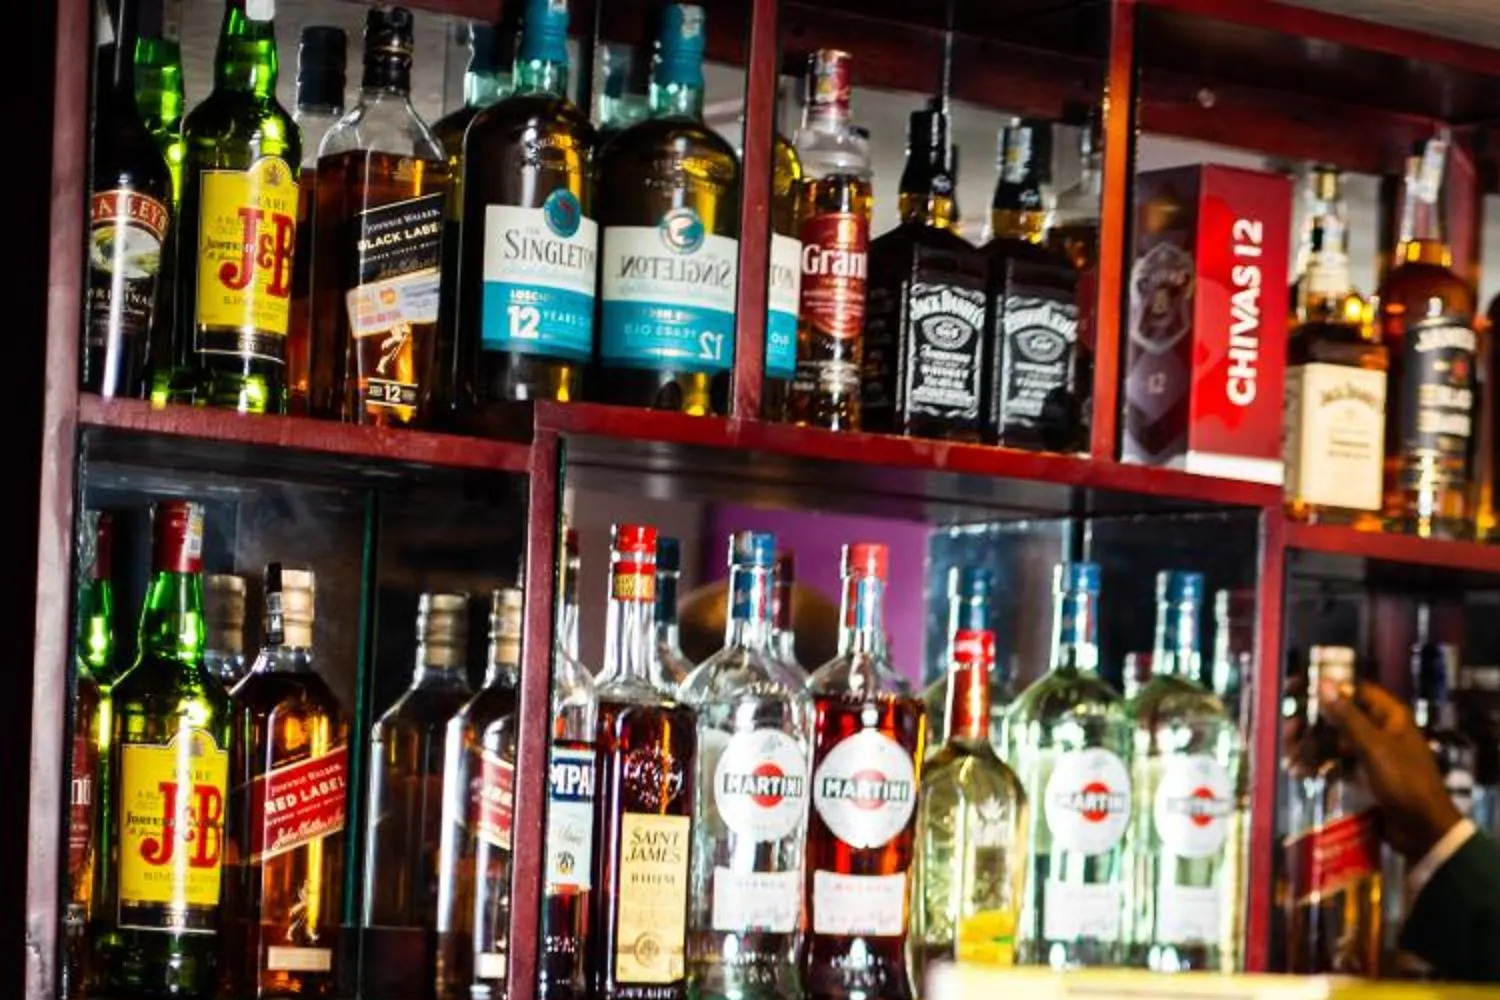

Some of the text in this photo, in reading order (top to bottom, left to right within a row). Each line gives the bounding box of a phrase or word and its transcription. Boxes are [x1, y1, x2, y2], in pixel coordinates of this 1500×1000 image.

[90, 197, 170, 232] ALEYS
[218, 206, 295, 299] J&B
[357, 231, 402, 252] BLACK
[507, 304, 541, 340] 12
[1226, 218, 1263, 407] CHIVAS 12
[384, 384, 401, 403] 12
[264, 792, 297, 814] RED
[300, 775, 347, 802] LABEL
[550, 763, 595, 796] MPA
[723, 772, 804, 798] MARTINI
[821, 775, 911, 802] MARTINI
[139, 781, 223, 868] J&B
[631, 827, 680, 847] SAINT
[625, 847, 682, 864] JAMES
